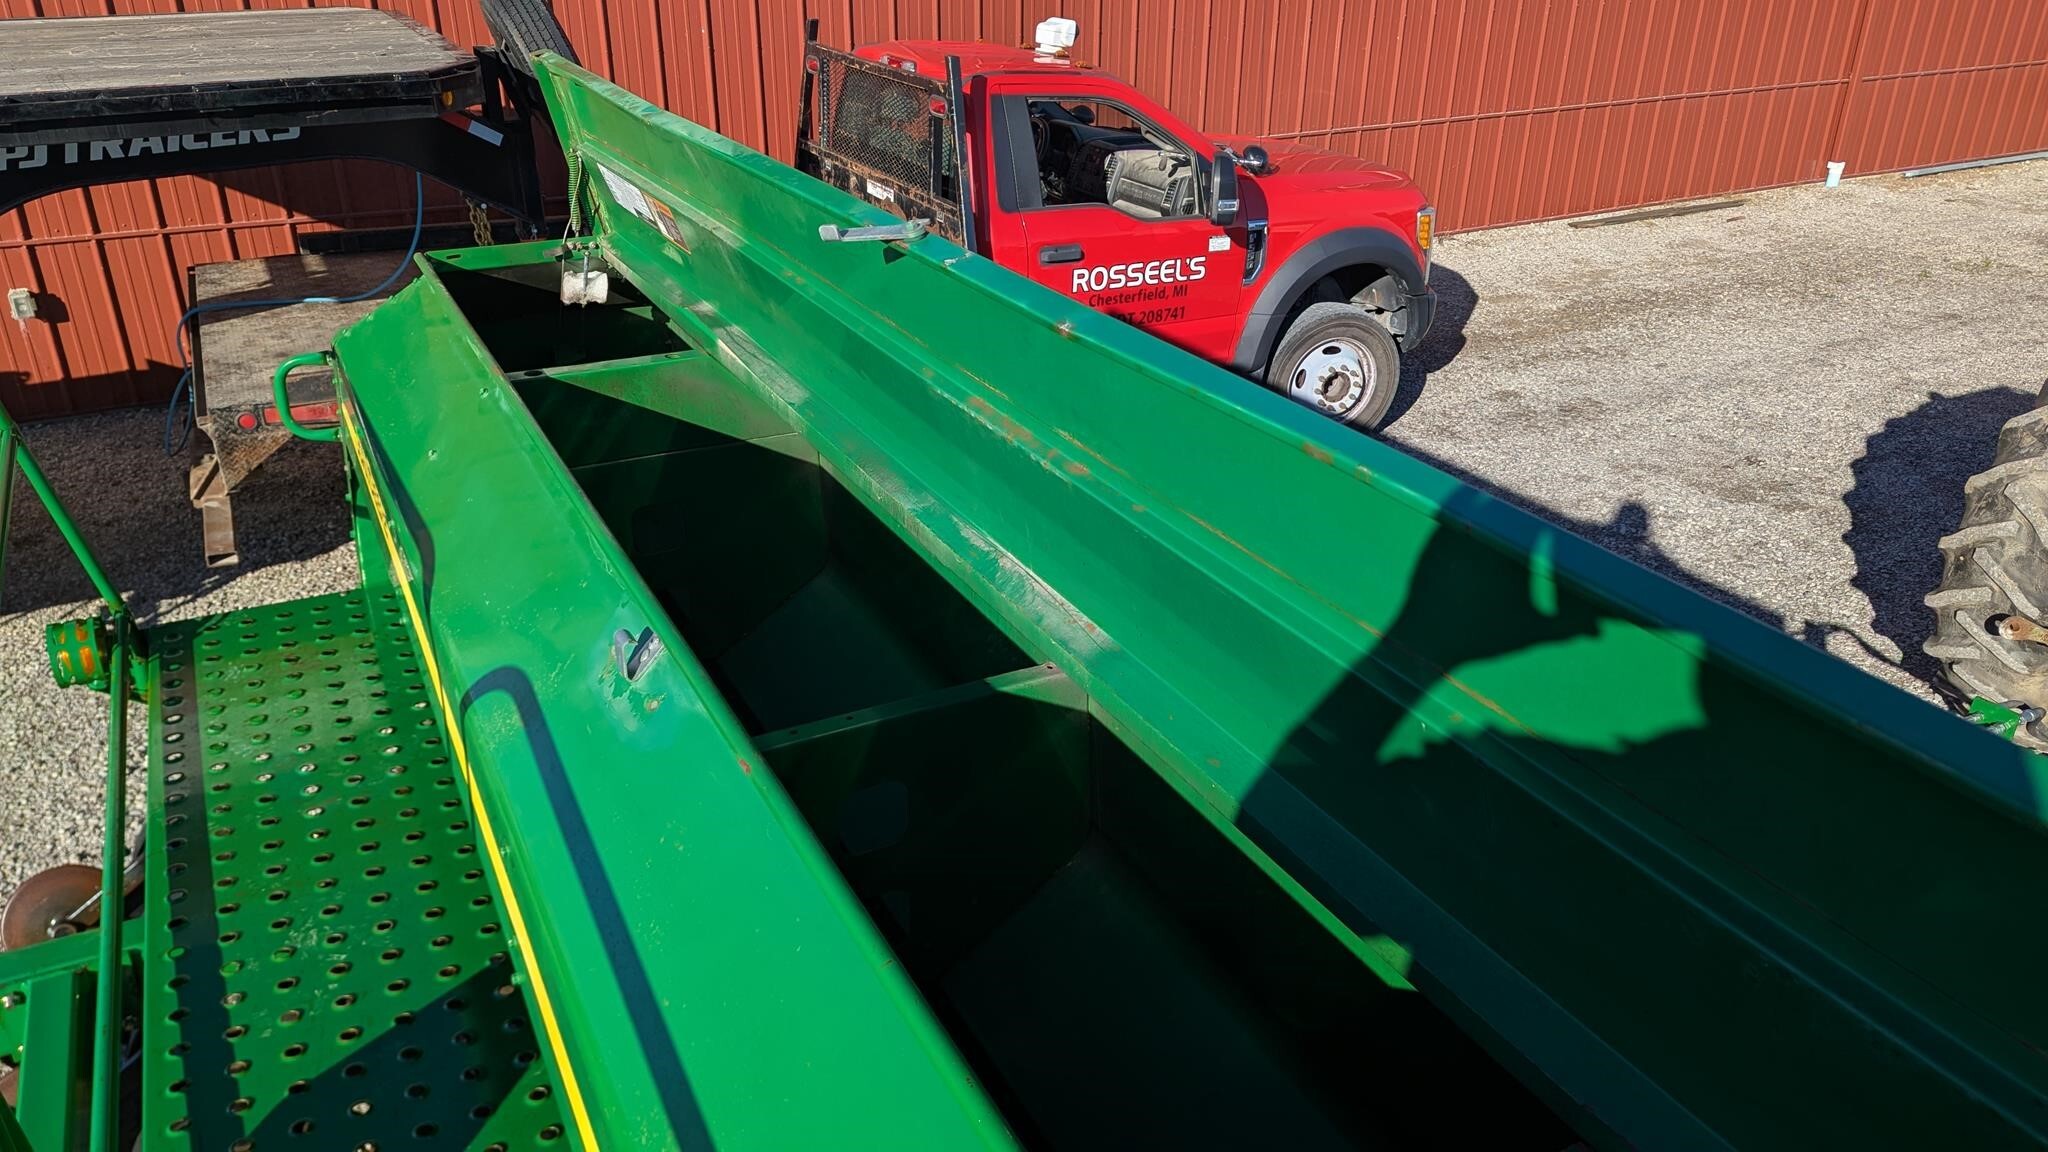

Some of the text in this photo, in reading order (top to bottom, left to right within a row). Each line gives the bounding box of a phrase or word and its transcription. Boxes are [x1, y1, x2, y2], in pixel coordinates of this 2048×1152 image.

[0, 145, 48, 171] PJ
[1072, 256, 1207, 293] ROSSEEL'S
[1088, 284, 1188, 308] Chesterfield, MI
[1139, 306, 1186, 325] 208741
